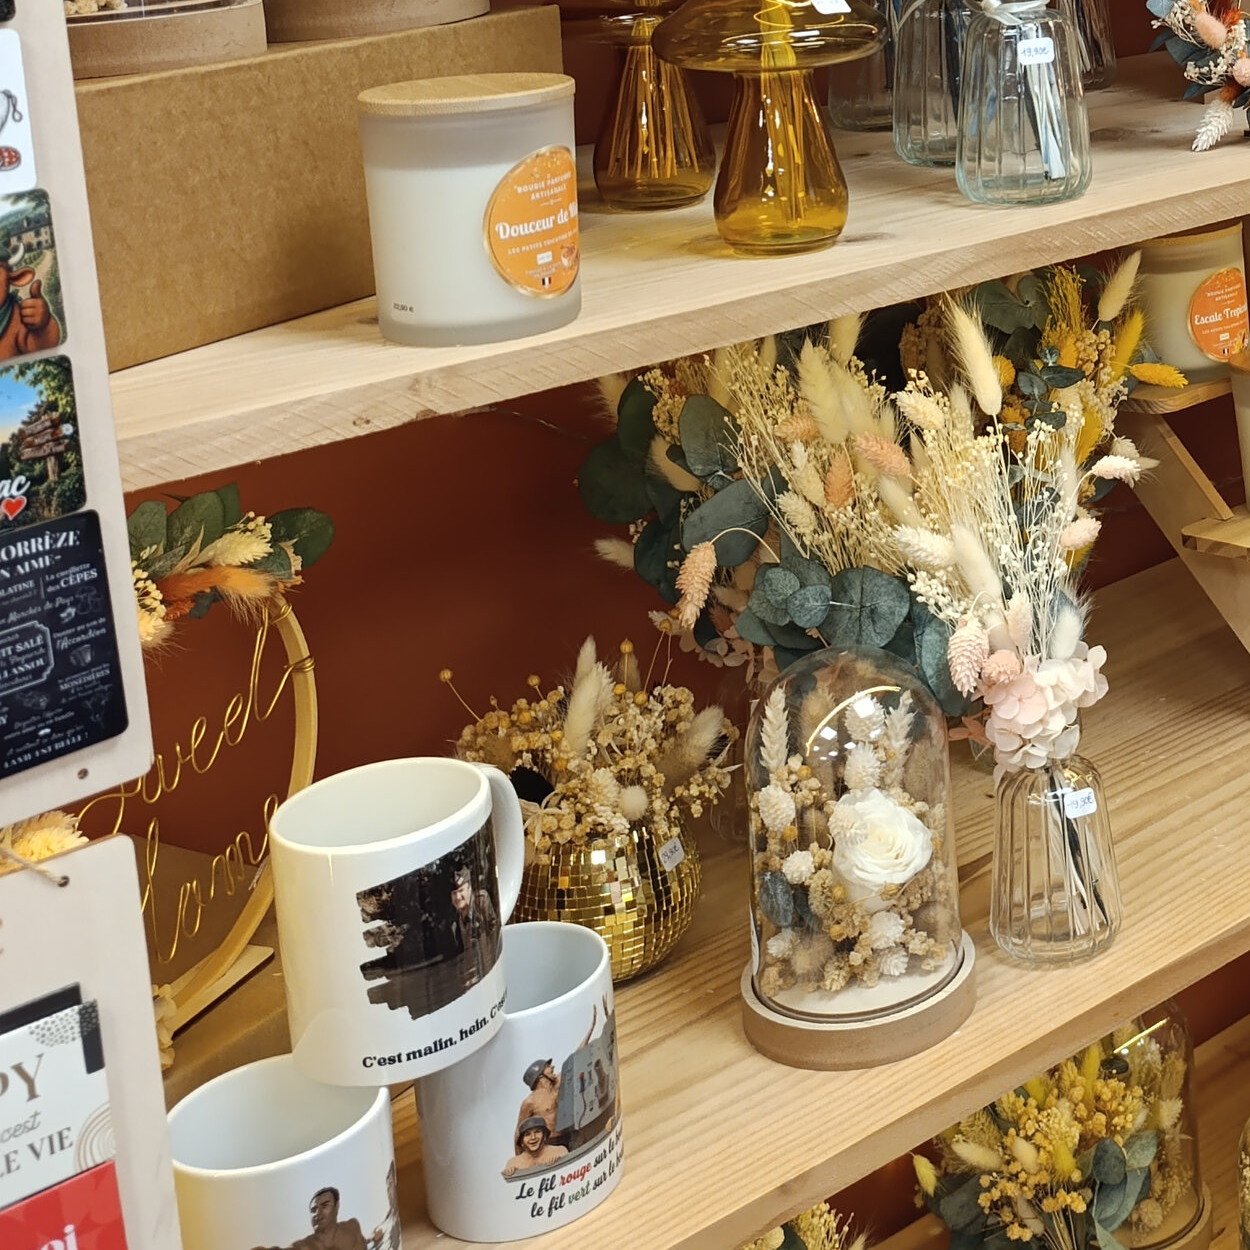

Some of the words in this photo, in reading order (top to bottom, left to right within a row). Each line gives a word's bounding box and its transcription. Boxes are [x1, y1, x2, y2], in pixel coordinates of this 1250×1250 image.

[495, 214, 555, 239] Douceur
[557, 208, 569, 225] de
[1194, 312, 1223, 326] Escale
[0, 530, 80, 562] ORRÈZE
[60, 568, 98, 588] CÈPES
[362, 1052, 403, 1068] C'est
[27, 1126, 75, 1162] VIE
[515, 1183, 535, 1200] Le
[538, 1173, 557, 1199] fil
[560, 1162, 592, 1186] rouge
[593, 1148, 607, 1167] sur
[608, 1137, 615, 1154] le
[531, 1202, 545, 1218] le
[548, 1192, 566, 1218] fil
[568, 1180, 592, 1205] vert
[592, 1171, 607, 1190] sur
[608, 1160, 615, 1176] le
